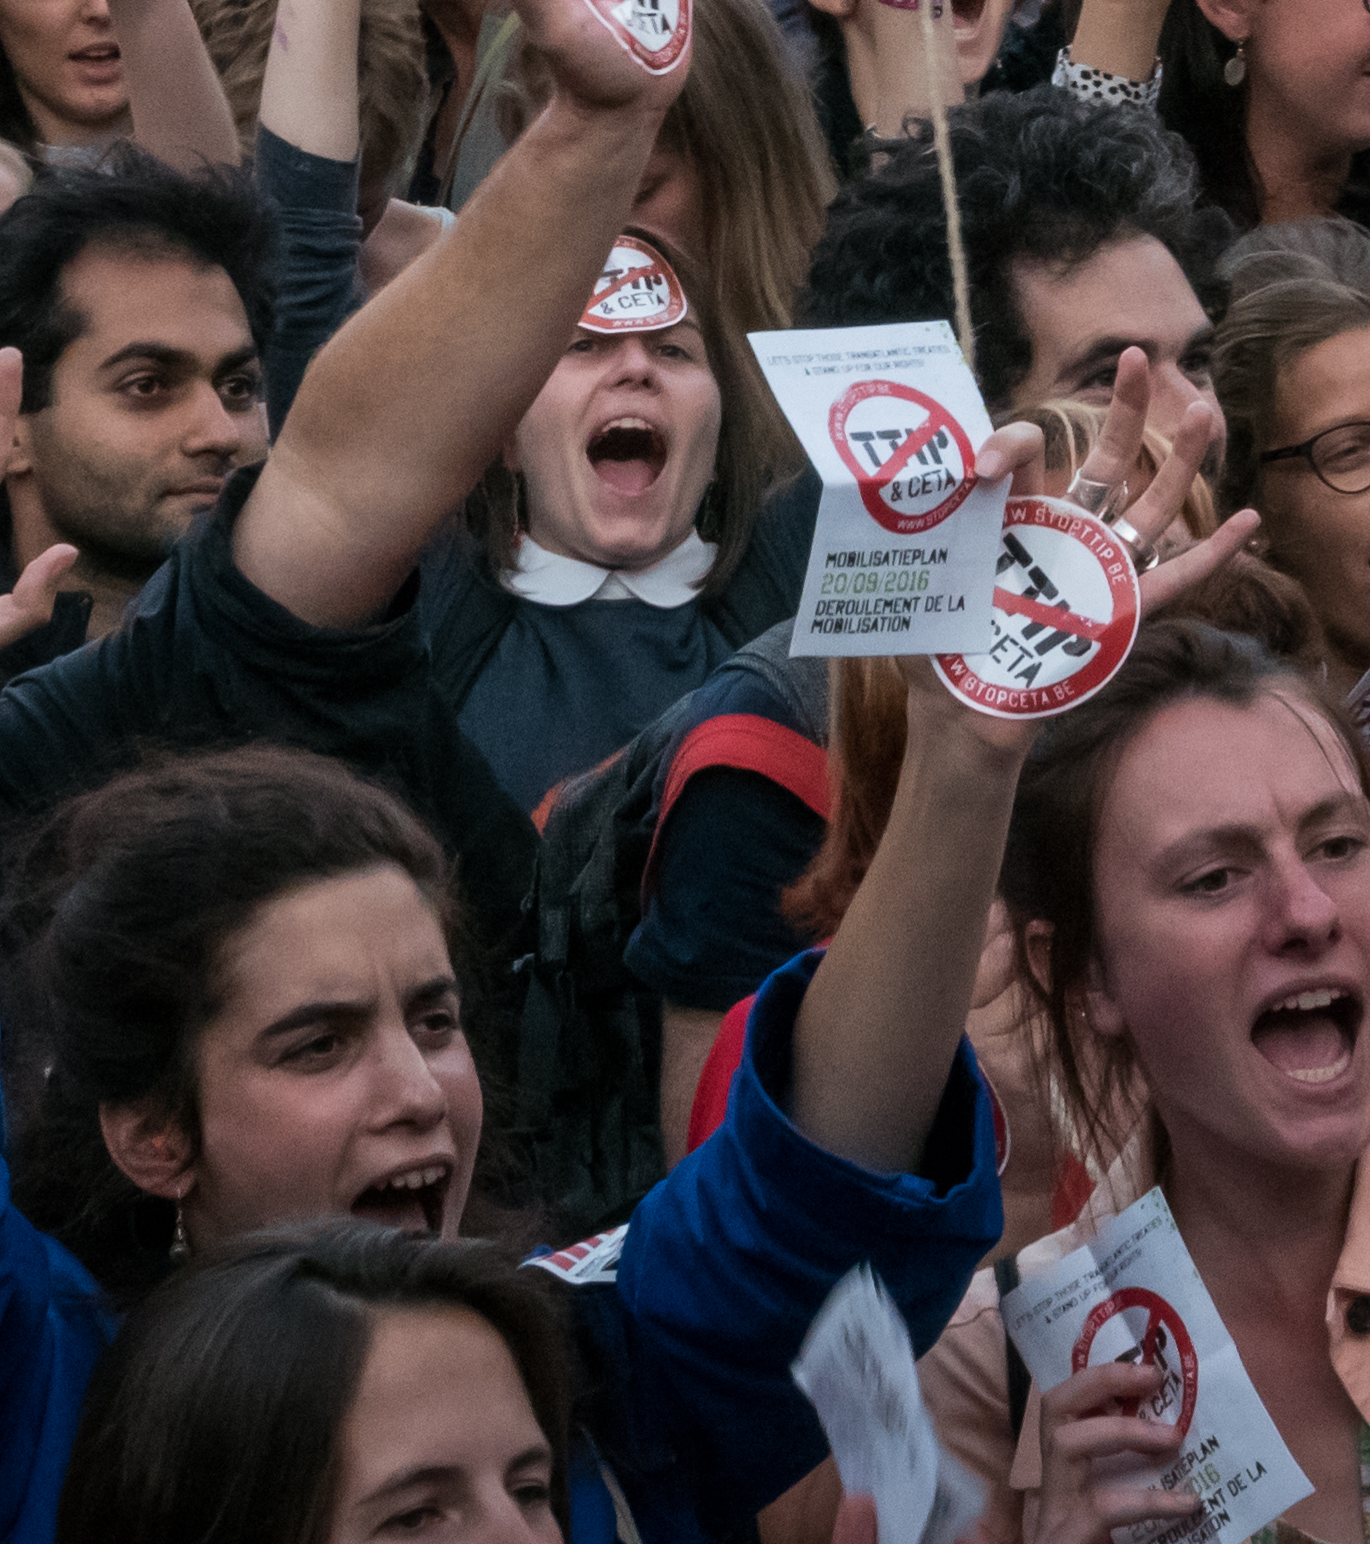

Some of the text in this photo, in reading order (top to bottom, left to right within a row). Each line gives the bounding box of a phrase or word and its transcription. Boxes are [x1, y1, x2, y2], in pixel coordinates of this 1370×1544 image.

[602, 267, 664, 292] TIP
[600, 291, 667, 315] & CETA
[849, 427, 949, 468] TTIP
[890, 467, 957, 503] & CETA
[825, 548, 949, 569] MOBILISATIEPLAN
[820, 570, 930, 595] 20/09/2016
[995, 533, 1095, 657] TTIP
[815, 594, 965, 617] DEROULEMENT DE LA
[810, 616, 912, 634] MOBILISATION
[989, 618, 1046, 689] ETA
[1151, 1368, 1183, 1418] CETA
[1228, 1472, 1249, 1499] DE
[1247, 1460, 1268, 1483] LA
